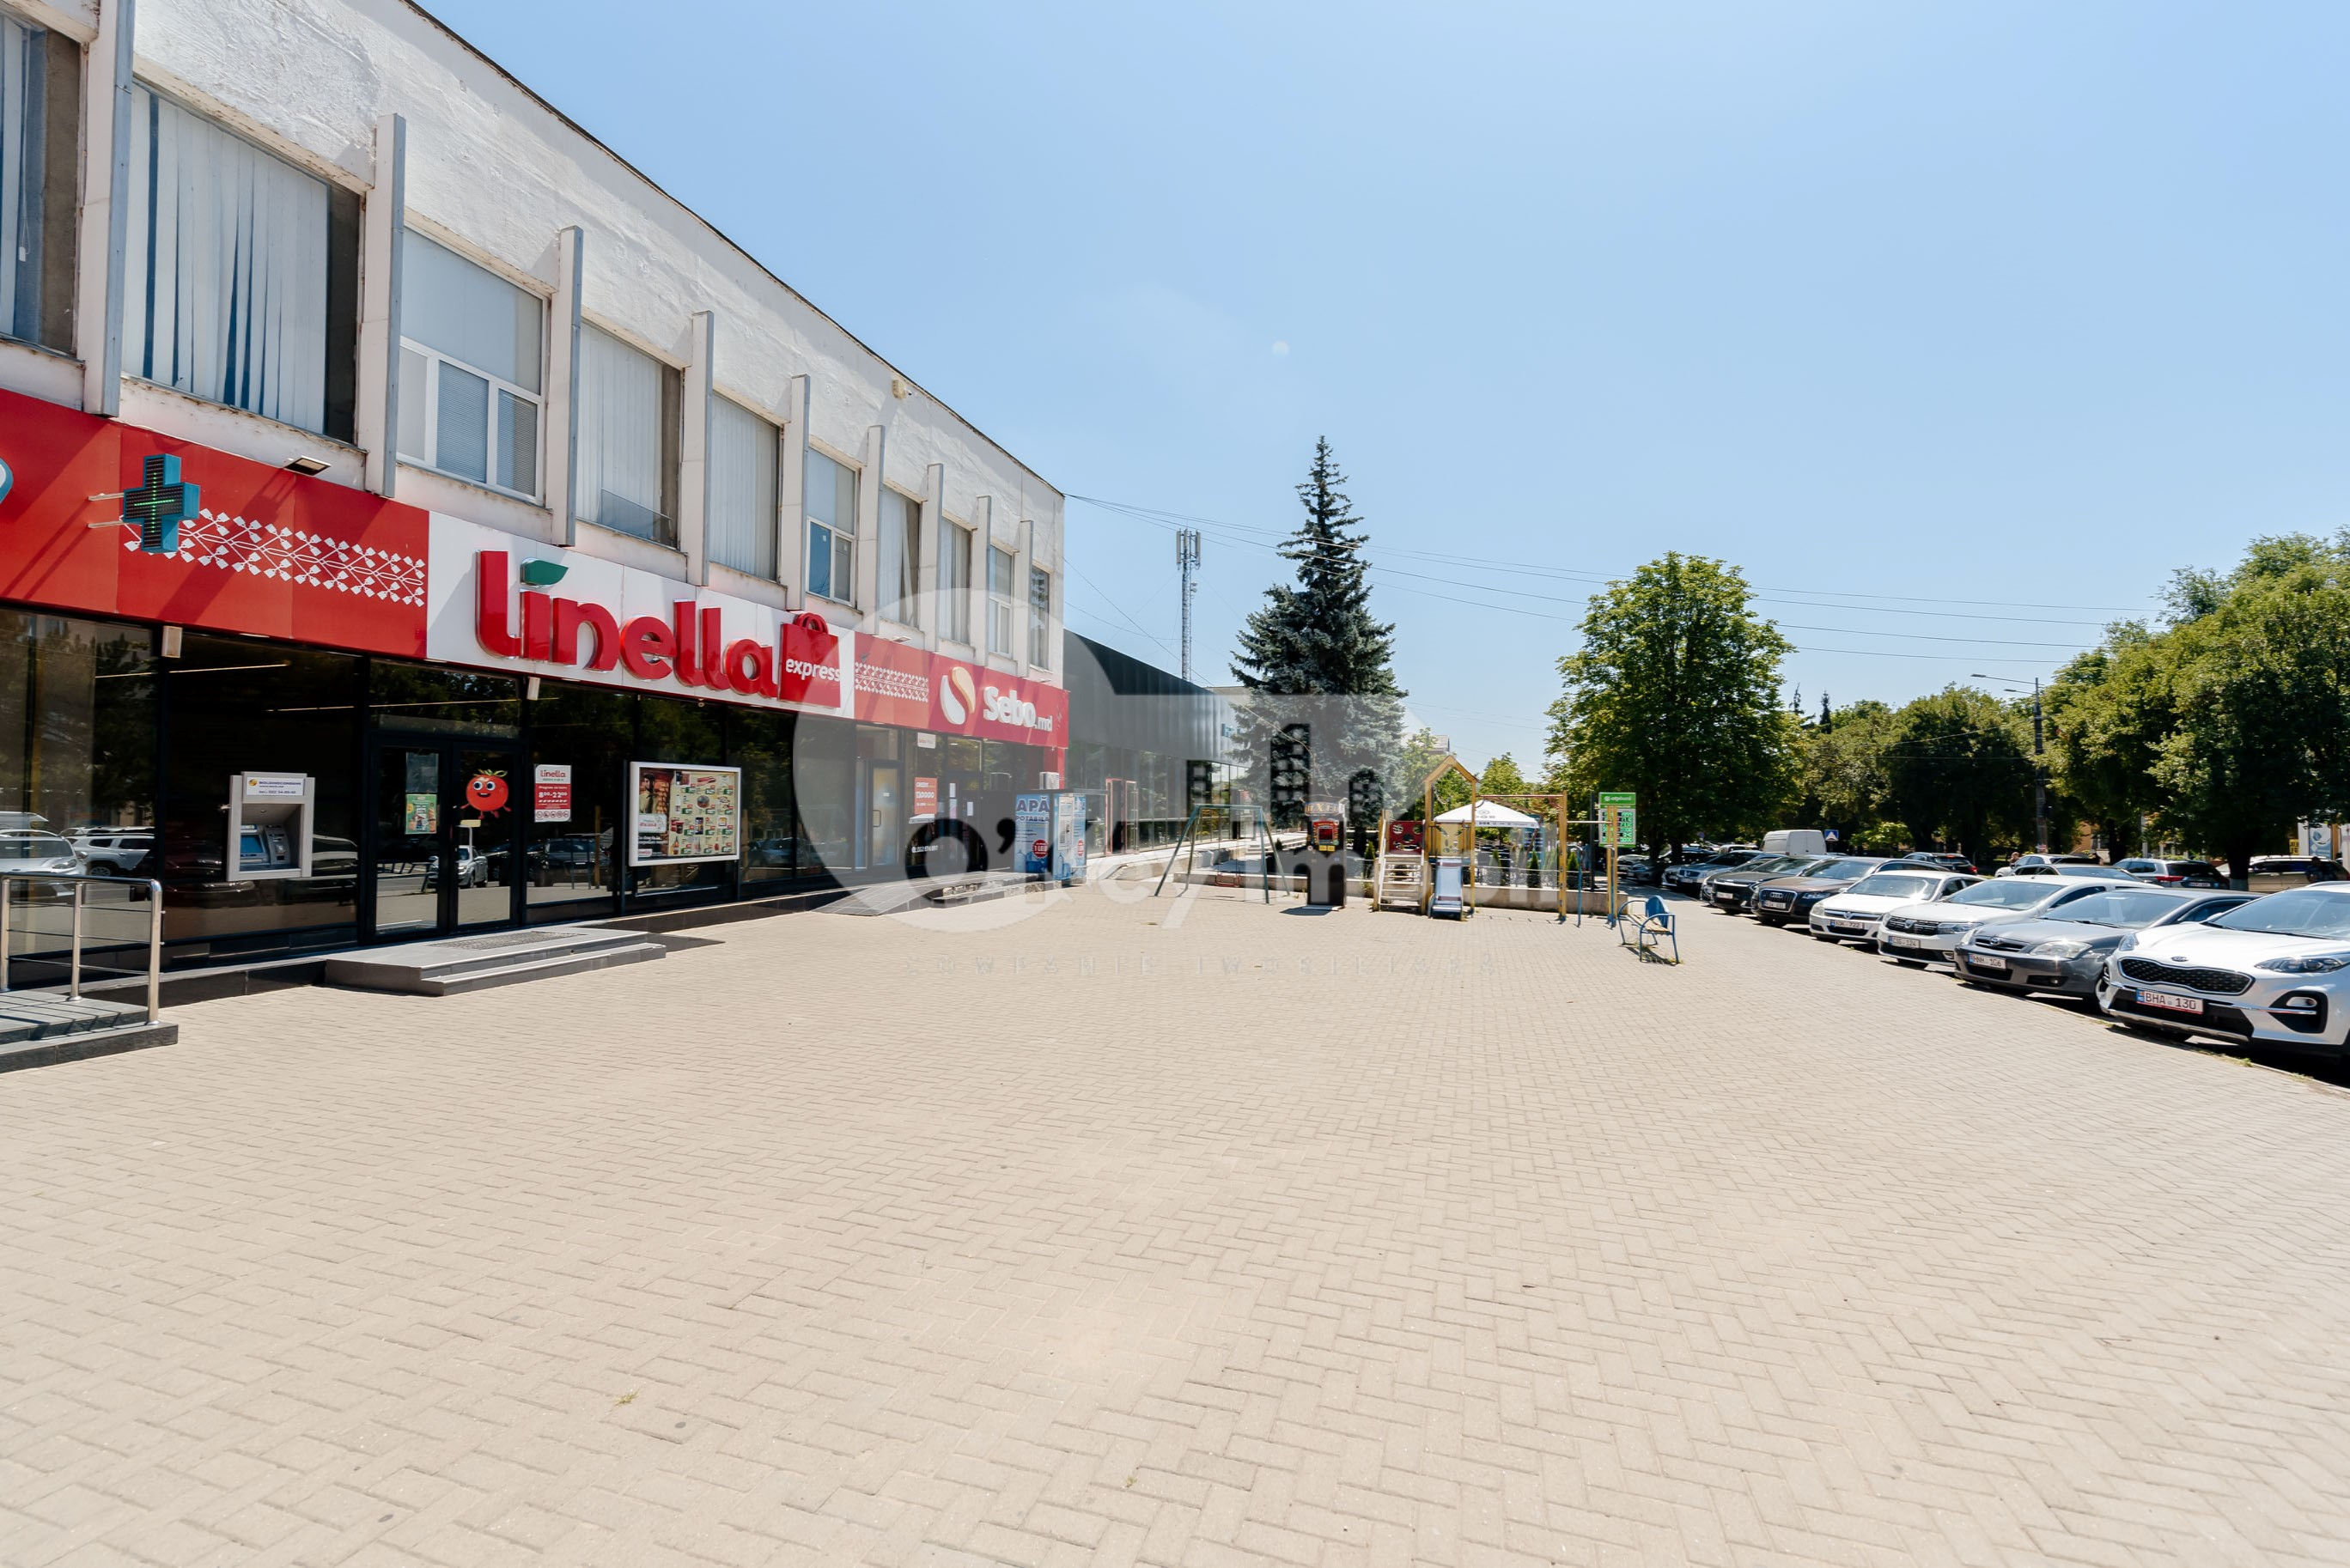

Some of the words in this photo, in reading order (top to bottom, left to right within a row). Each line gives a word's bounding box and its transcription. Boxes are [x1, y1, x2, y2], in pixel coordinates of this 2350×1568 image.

[785, 659, 841, 681] express
[1016, 795, 1050, 812] APĂ
[2146, 992, 2165, 1005] BHA
[2176, 998, 2196, 1010] 130
